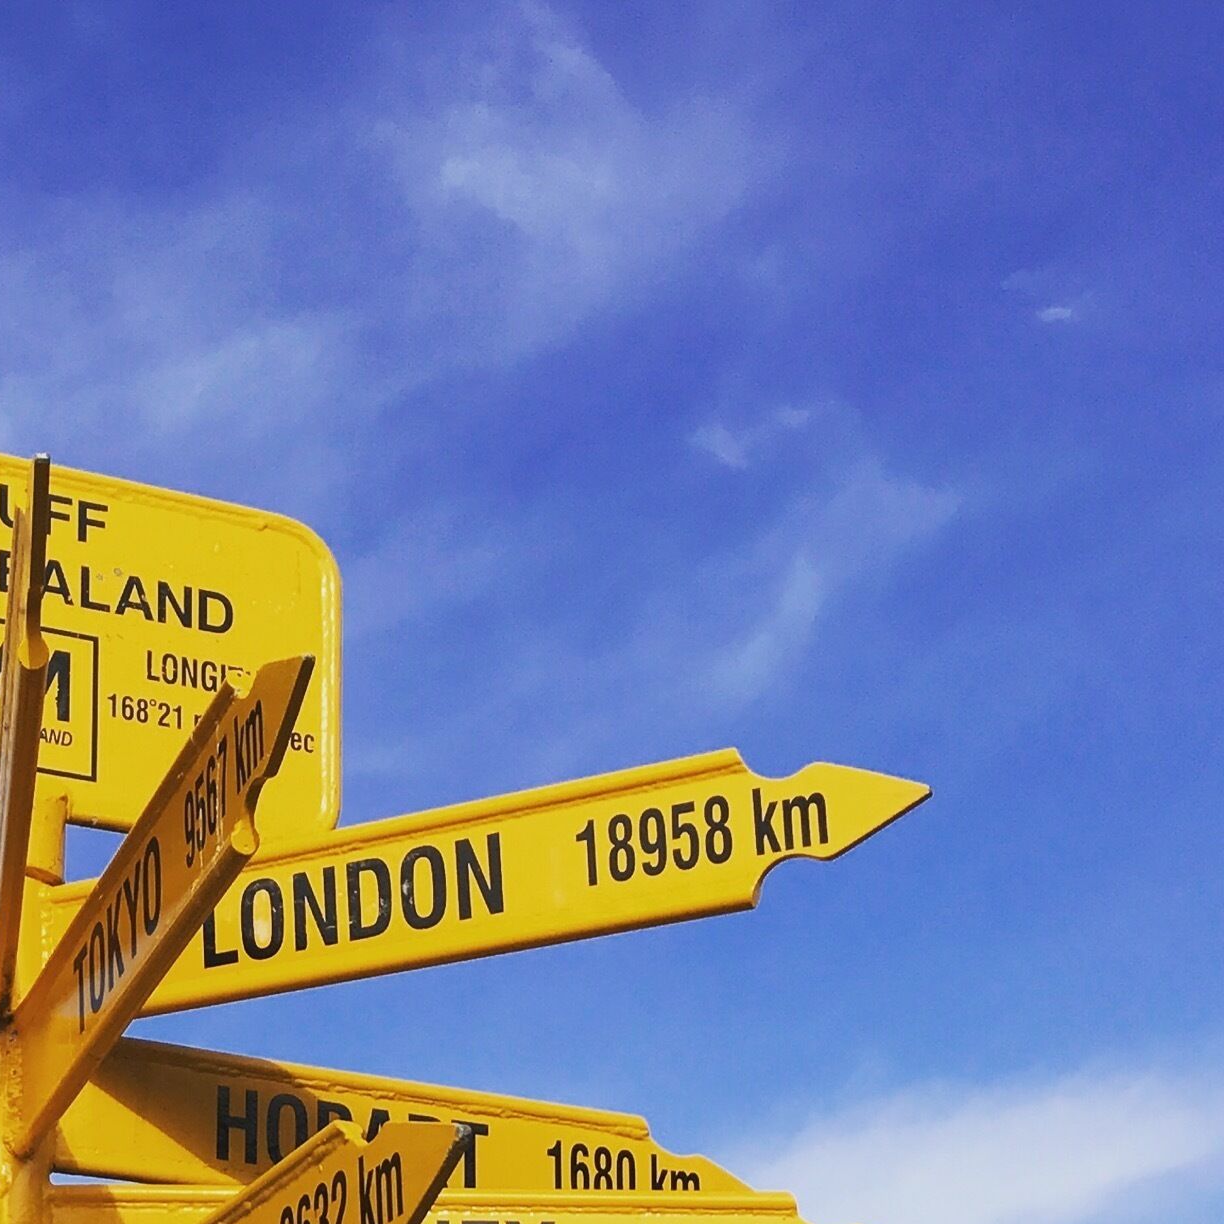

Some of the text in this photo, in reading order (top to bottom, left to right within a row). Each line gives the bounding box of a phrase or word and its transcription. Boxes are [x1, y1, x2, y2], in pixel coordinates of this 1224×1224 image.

[146, 650, 252, 693] LONGI
[73, 699, 264, 1035] TOKYO 9567 km
[203, 788, 830, 968] LONDON 18958 km
[547, 1139, 636, 1190] 1680
[651, 1154, 700, 1191] km
